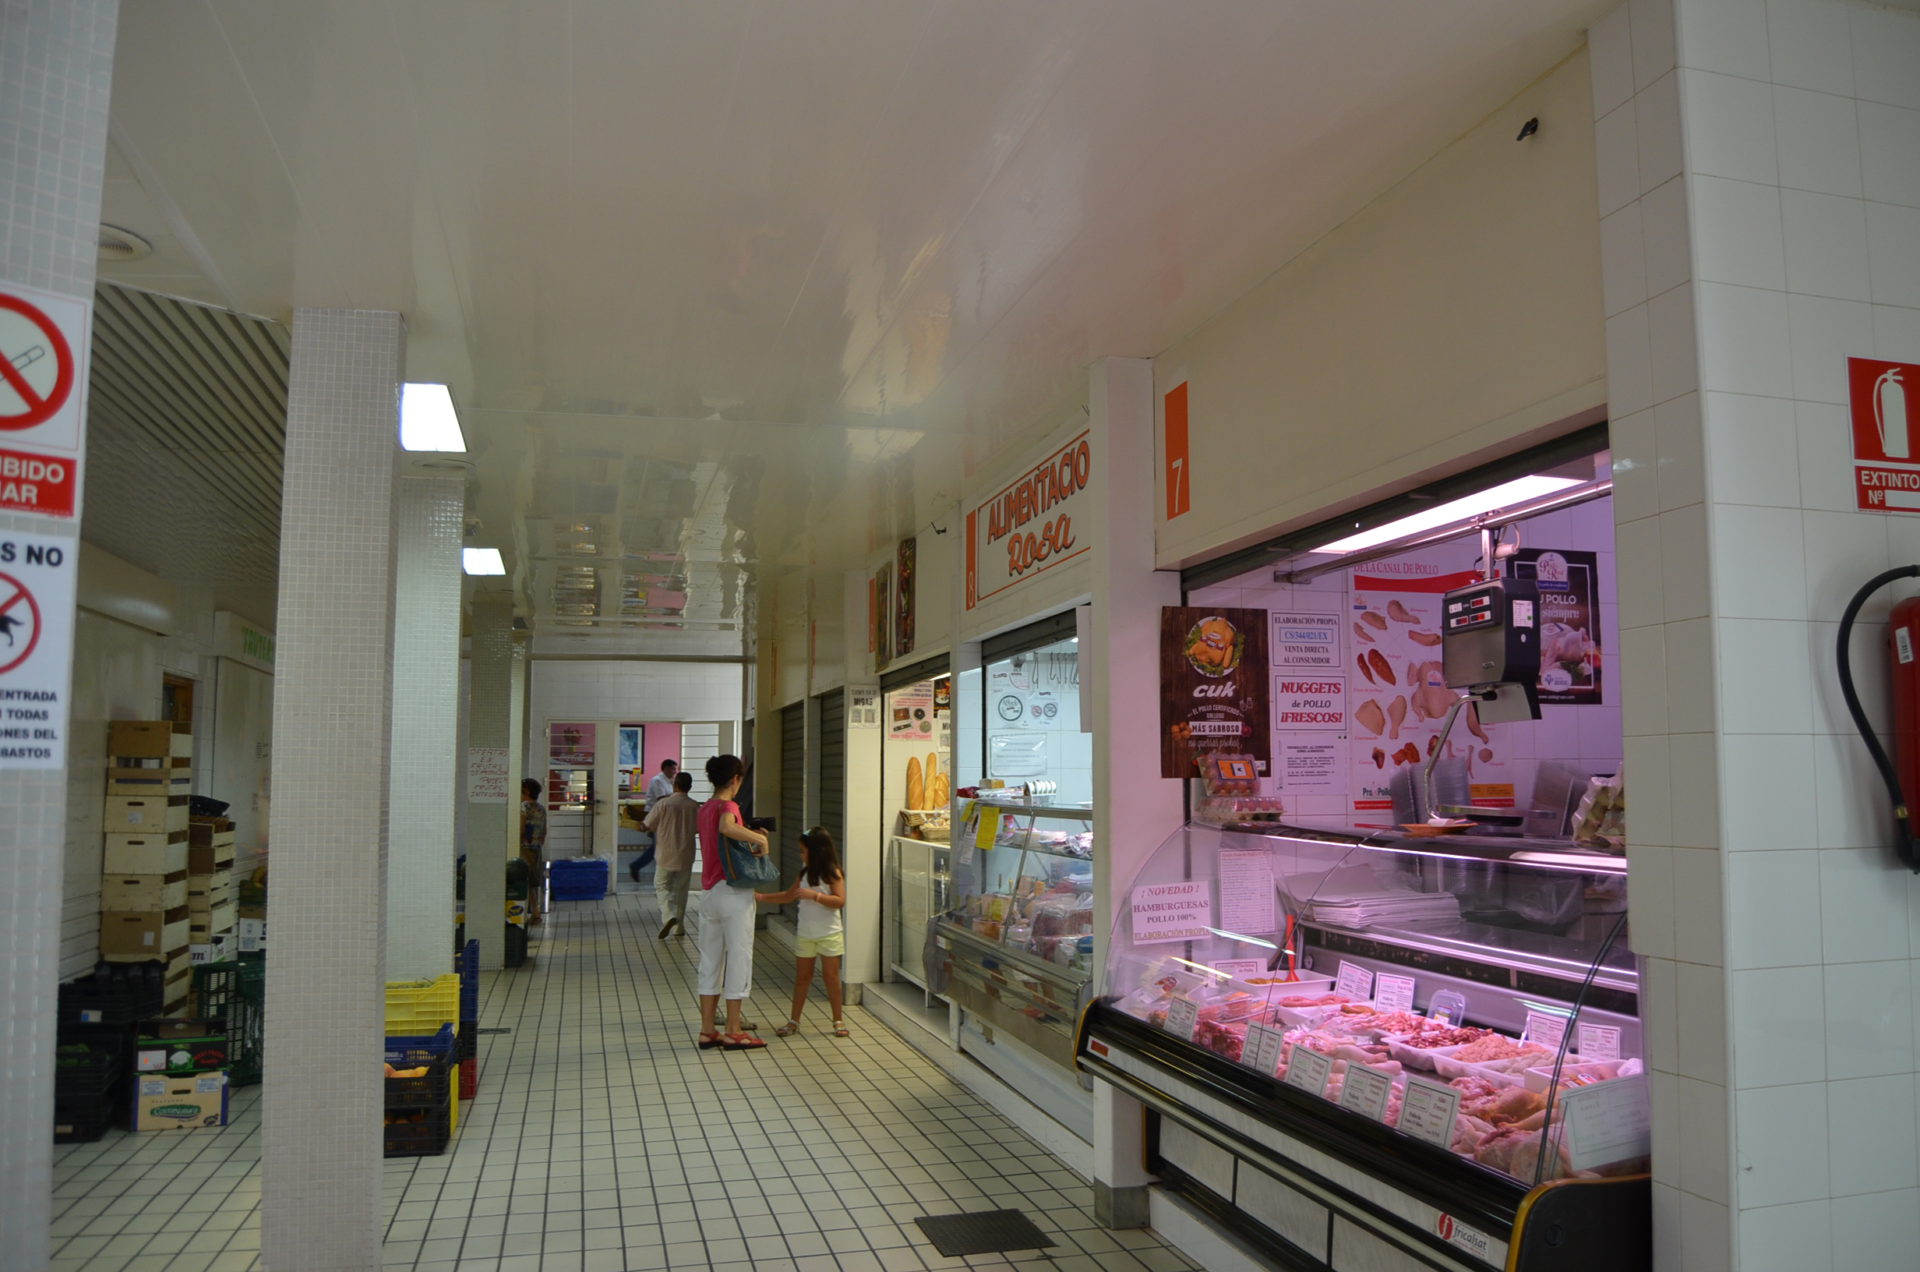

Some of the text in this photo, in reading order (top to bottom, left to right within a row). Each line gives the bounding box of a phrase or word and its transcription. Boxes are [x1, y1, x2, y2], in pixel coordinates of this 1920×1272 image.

[1172, 458, 1183, 514] 7
[987, 440, 1091, 545] ALIMENTACIO
[1868, 490, 1883, 505] Nº
[26, 544, 64, 568] NO
[1376, 562, 1401, 573] CANAL
[1403, 562, 1413, 574] DE
[1415, 562, 1439, 575] POLLO
[968, 570, 974, 606] 8
[1547, 595, 1577, 604] POLLO
[1275, 616, 1315, 625] ELABORACIÓN
[1193, 681, 1236, 698] cuk
[1281, 682, 1341, 694] NUGGETS
[1292, 700, 1331, 708] de POLLO
[6, 708, 49, 721] TODAS
[1280, 712, 1343, 724] ¡FRESCOS!
[1192, 723, 1240, 733] MÁS SABROSO
[34, 729, 58, 740] DEL
[1148, 885, 1194, 896] NOVEDAD
[1133, 900, 1208, 913] HAMBURGUESAS
[1147, 914, 1197, 924] POLLO 100%
[1134, 929, 1183, 941] ELABORACIÓN
